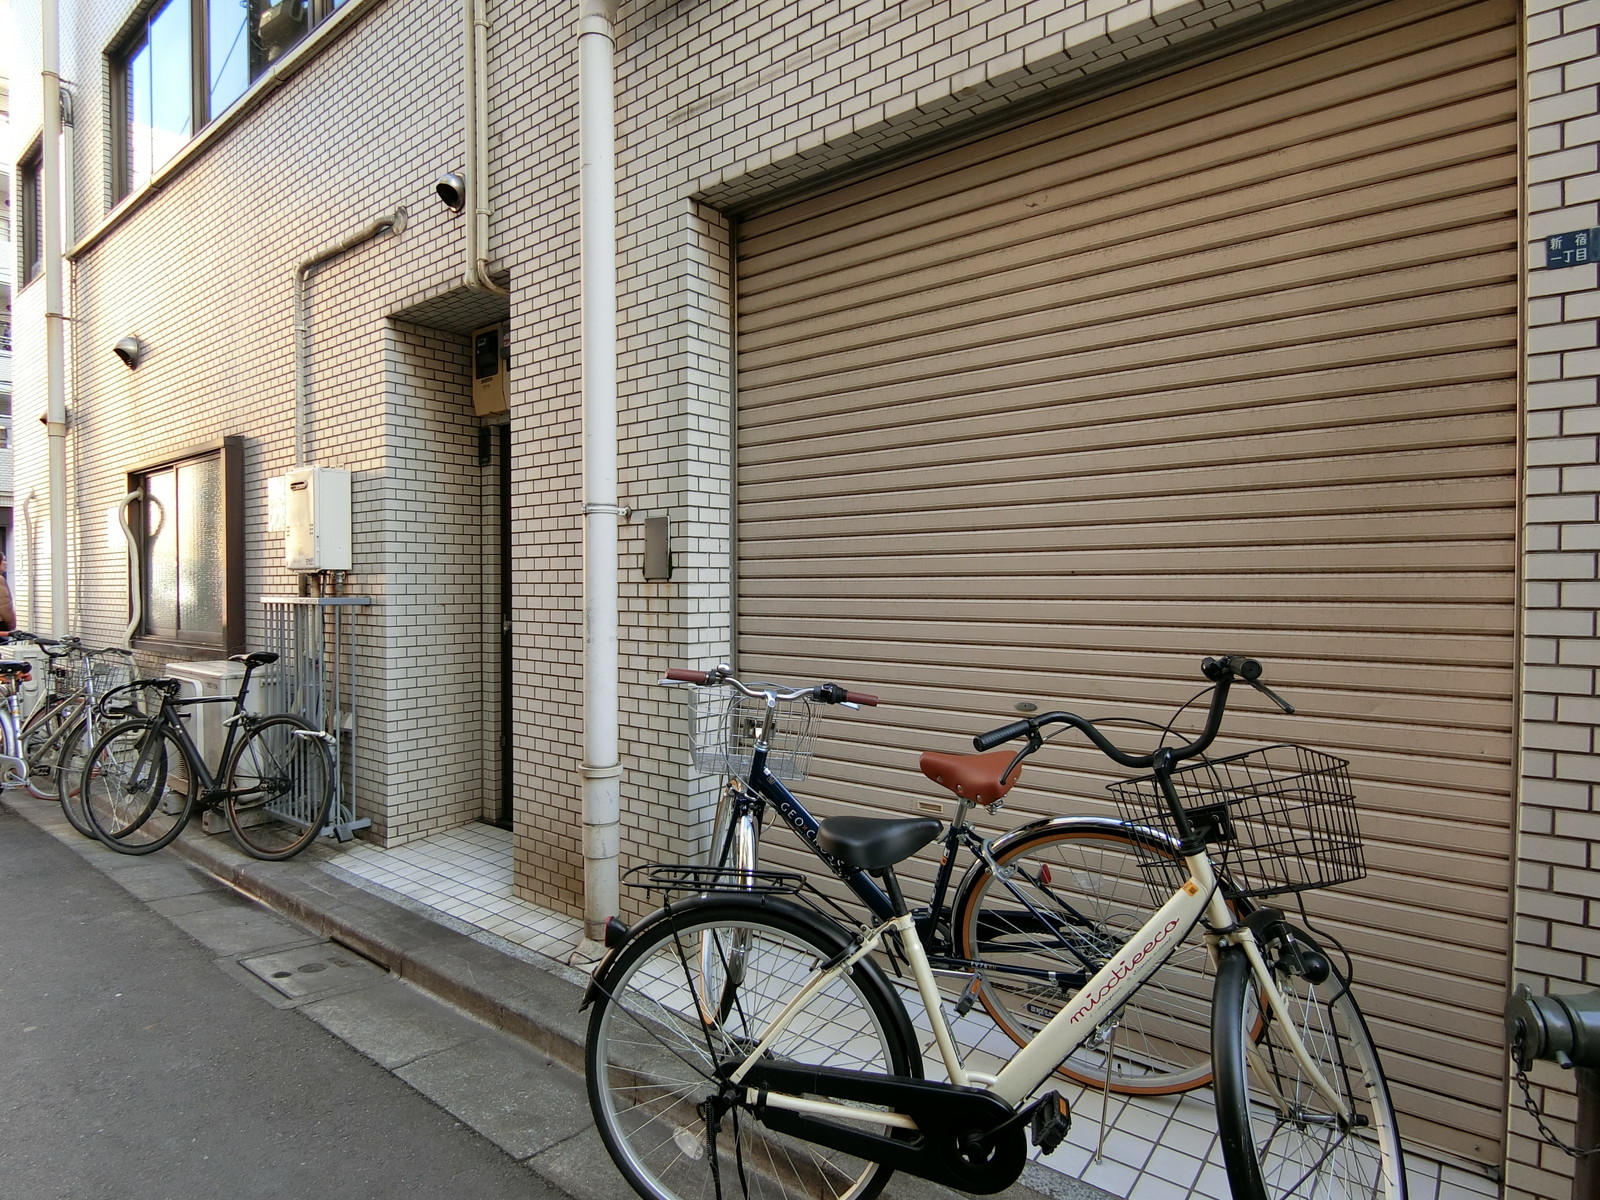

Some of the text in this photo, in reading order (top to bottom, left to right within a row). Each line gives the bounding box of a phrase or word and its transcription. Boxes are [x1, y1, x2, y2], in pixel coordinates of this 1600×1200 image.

[1550, 233, 1587, 251] 新宿
[1550, 248, 1587, 263] 一丁目
[780, 802, 804, 827] GEO
